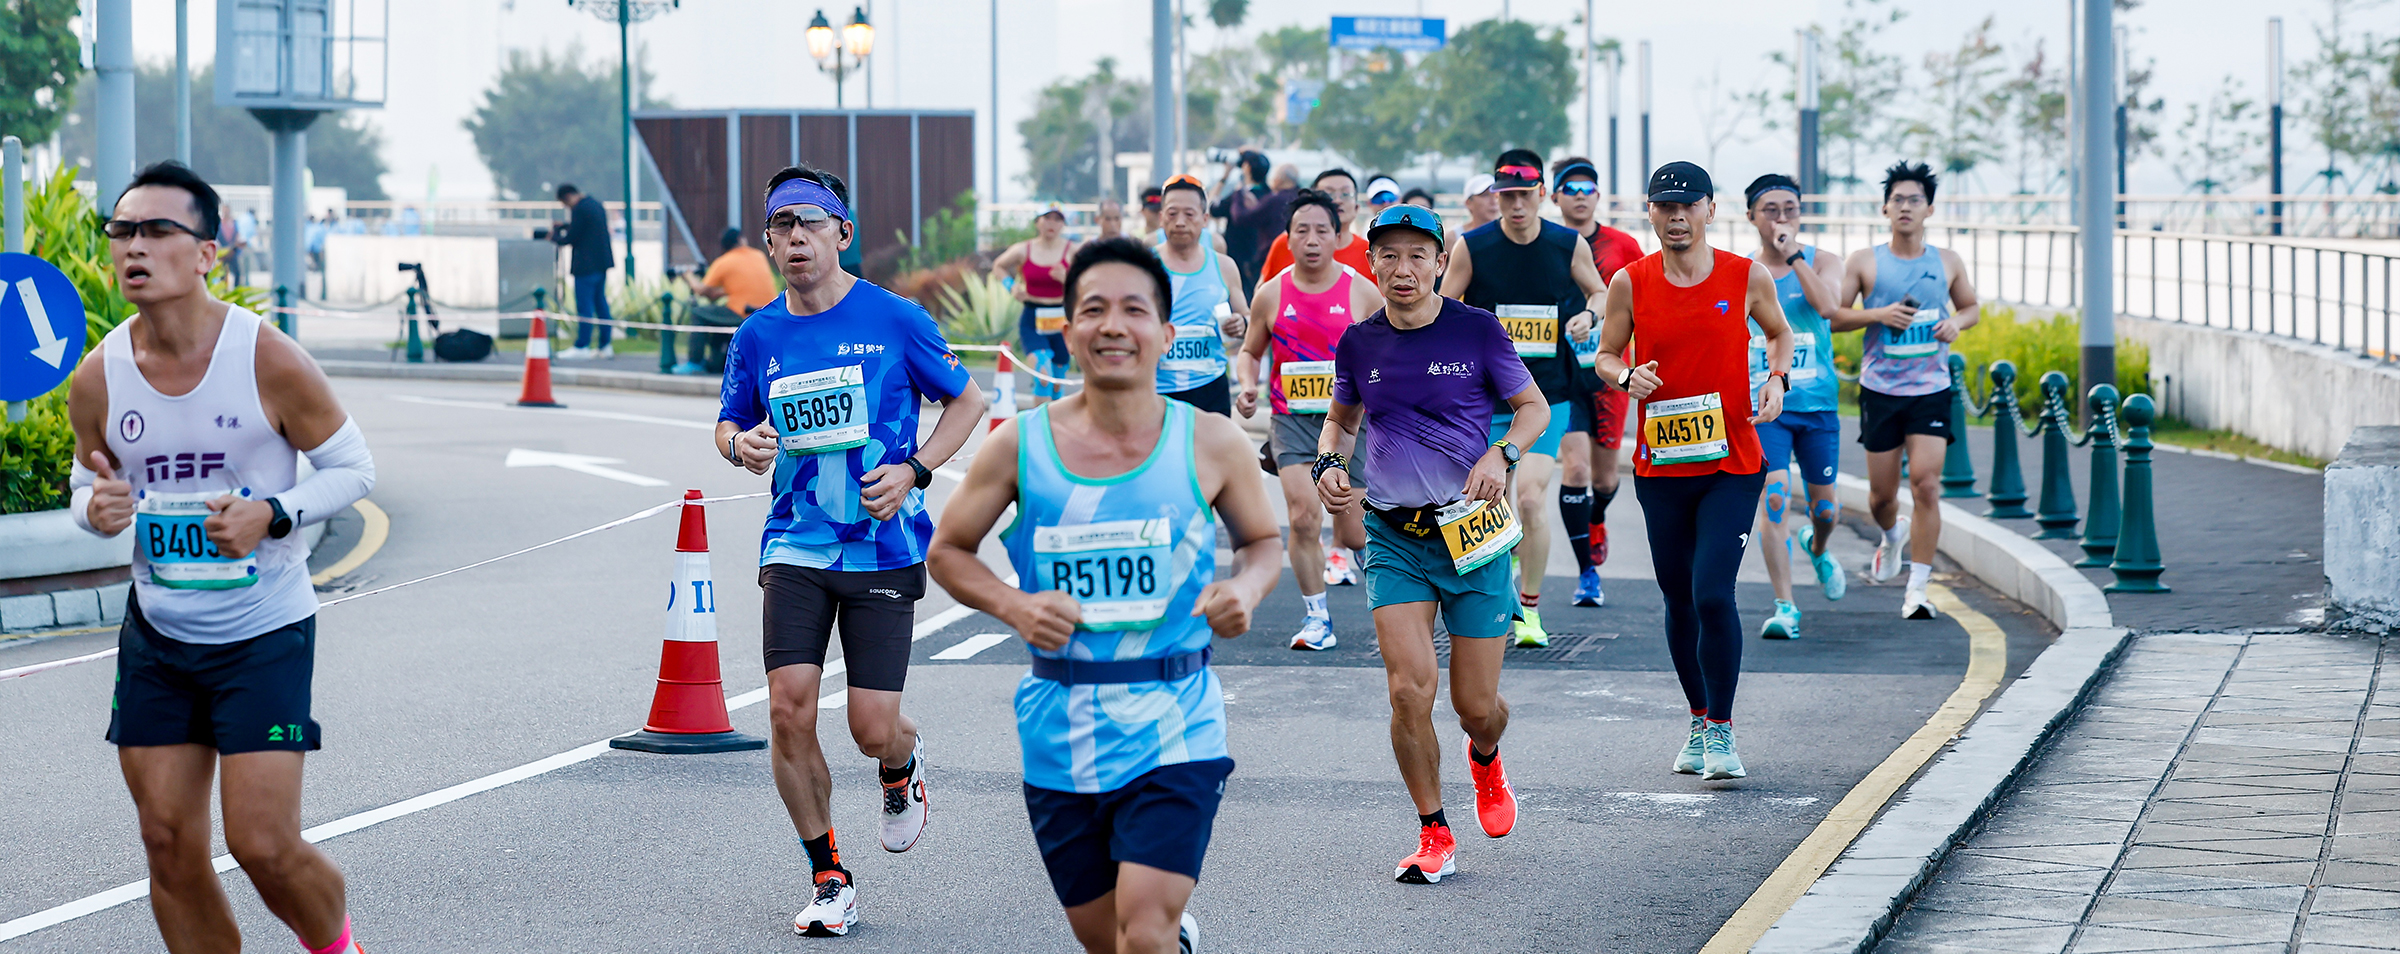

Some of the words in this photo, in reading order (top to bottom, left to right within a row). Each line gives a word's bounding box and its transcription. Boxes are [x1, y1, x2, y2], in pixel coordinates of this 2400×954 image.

[1506, 321, 1552, 341] A4316
[1167, 340, 1210, 359] B5506
[1290, 377, 1334, 398] A5176
[782, 392, 853, 433] B5859
[1657, 414, 1715, 445] A4519
[1458, 501, 1511, 552] A5404
[1053, 556, 1156, 598] B5198
[287, 723, 304, 742] T8
